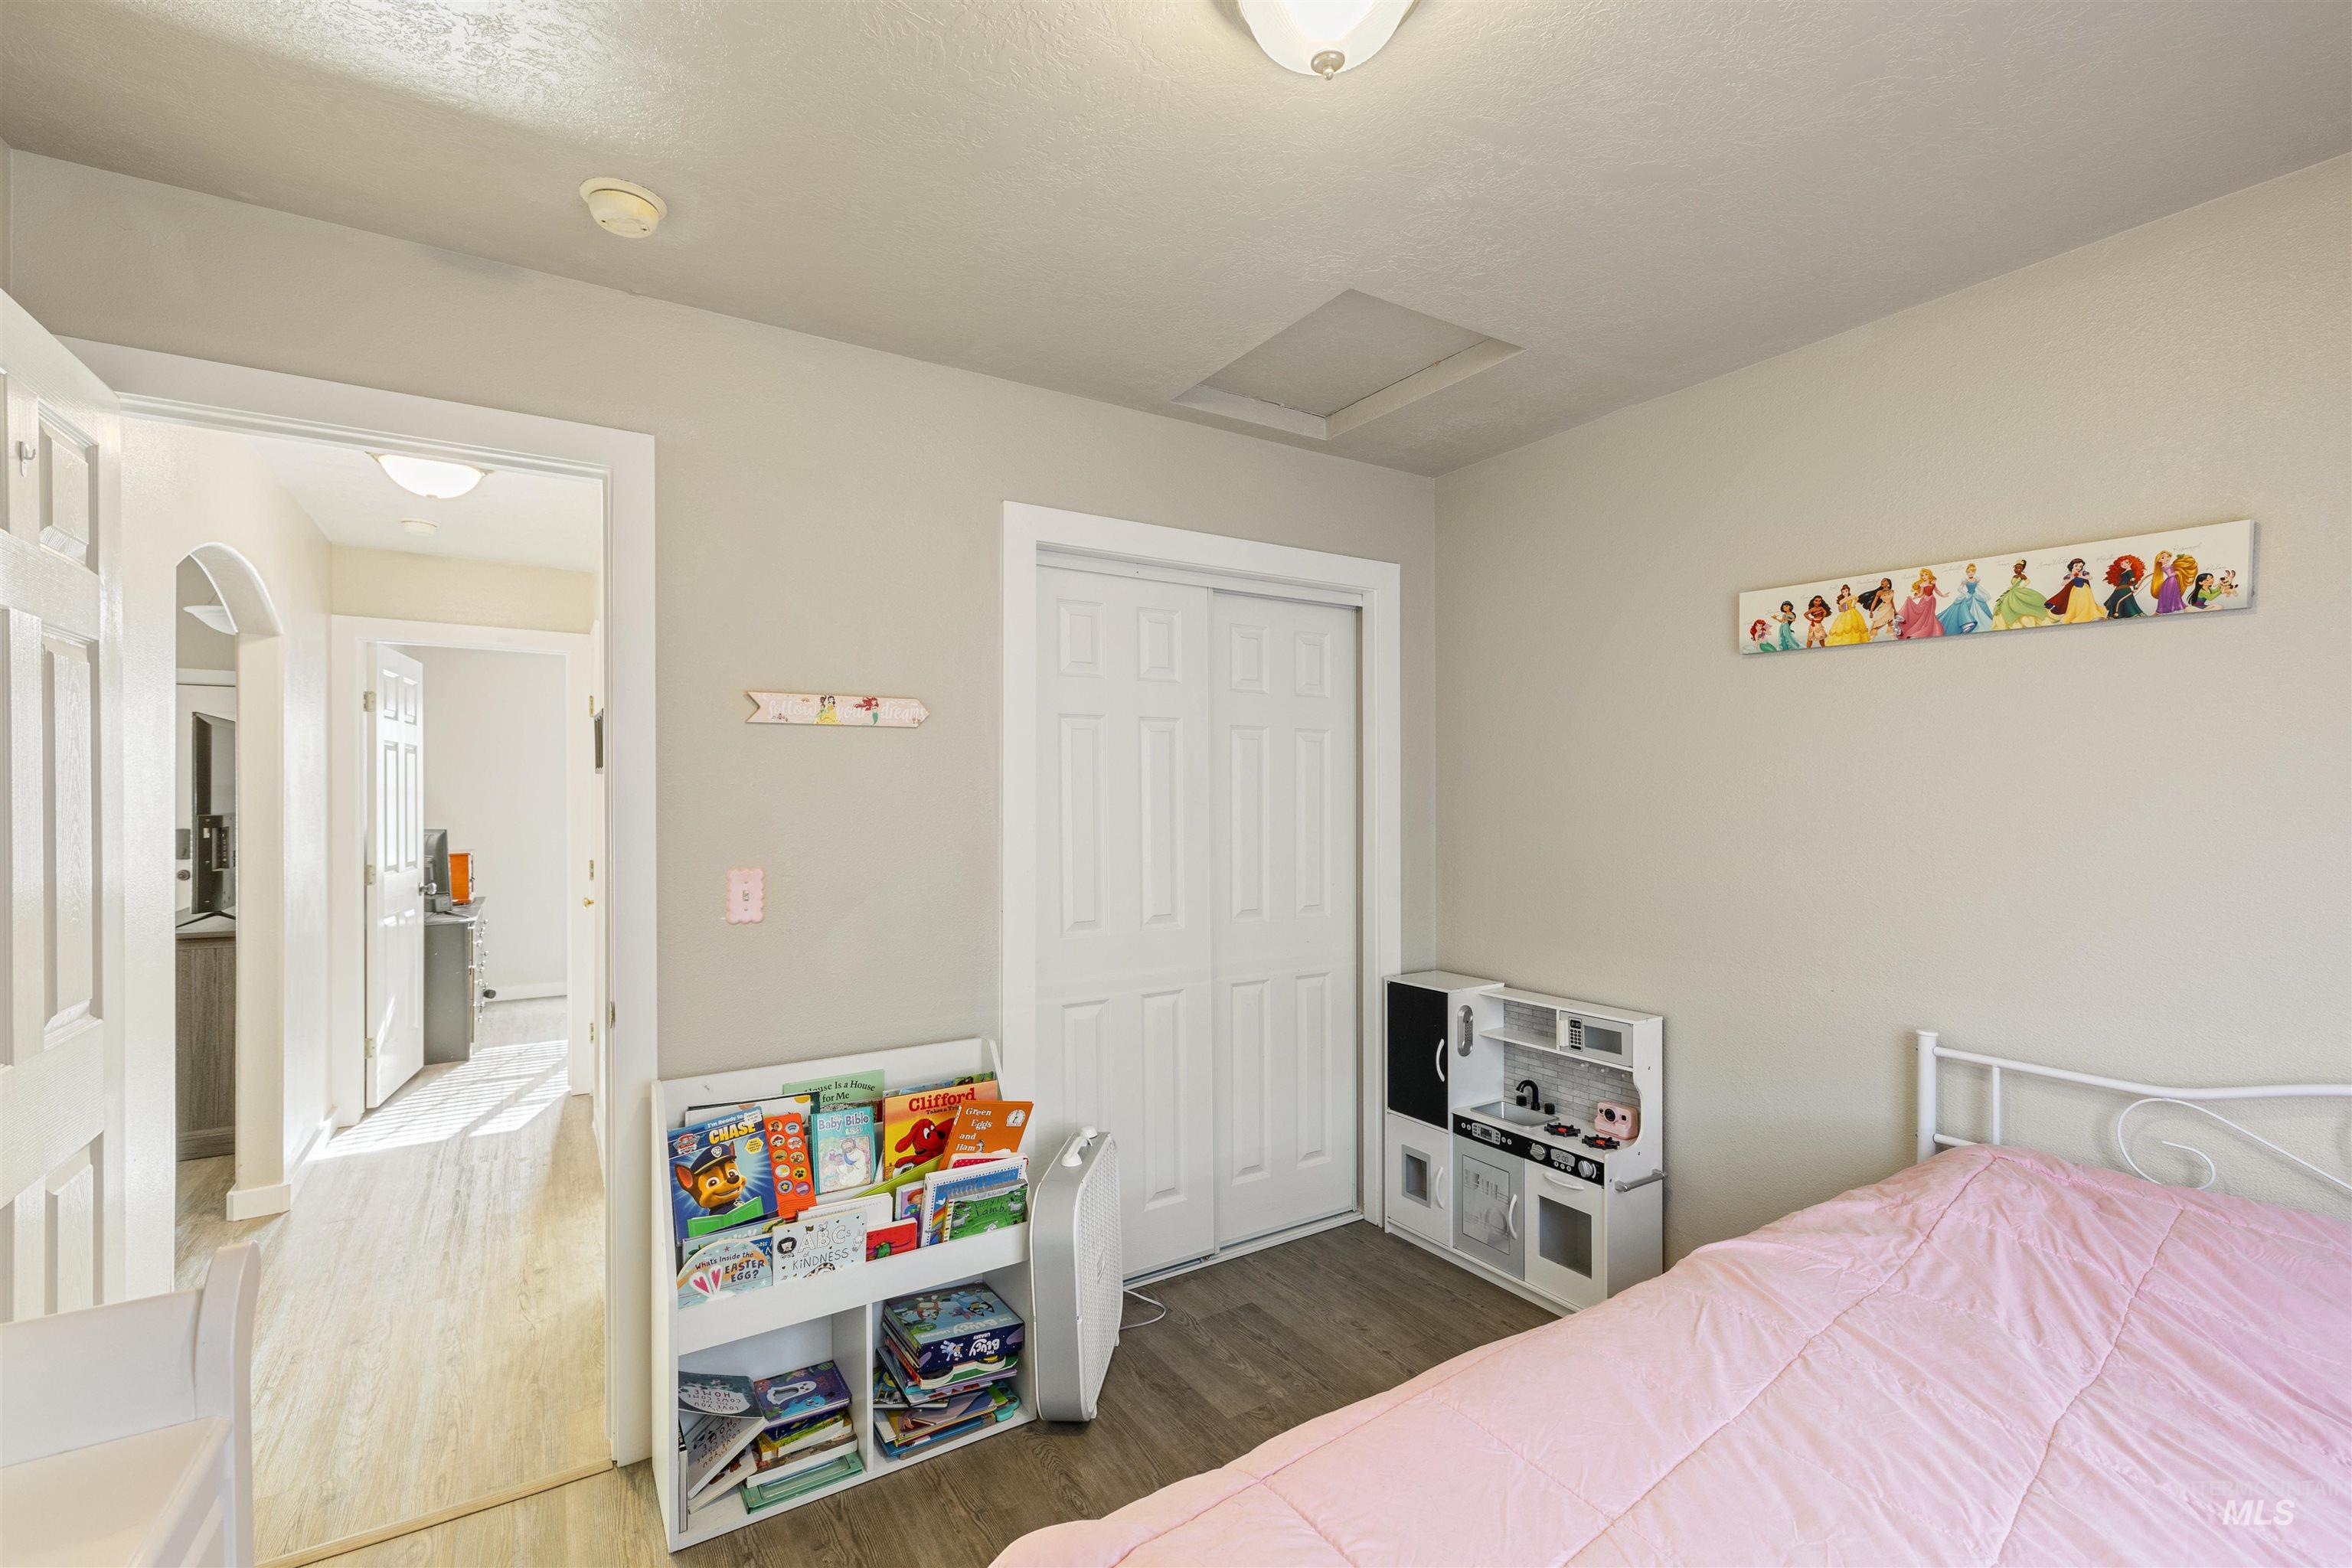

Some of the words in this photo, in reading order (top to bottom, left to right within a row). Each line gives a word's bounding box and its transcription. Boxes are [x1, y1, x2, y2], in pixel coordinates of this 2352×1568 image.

[769, 700, 816, 717] follow
[835, 708, 866, 721] your
[881, 702, 926, 720] dreams
[850, 1080, 876, 1092] House
[835, 1092, 850, 1101] Me
[909, 1087, 977, 1112] Clifford
[965, 1107, 991, 1116] Green
[718, 1116, 737, 1125] Ready
[818, 1117, 842, 1131] Baby
[845, 1112, 869, 1126] Bible
[971, 1119, 992, 1130] Eggs
[709, 1121, 756, 1145] CHASE
[956, 1143, 975, 1152] Ham
[798, 1224, 851, 1253] ABCs
[695, 1258, 717, 1270] What's
[720, 1253, 740, 1263] Inside
[724, 1259, 765, 1274] EASTER
[731, 1269, 760, 1283] EGG?
[694, 1390, 730, 1398] HOME
